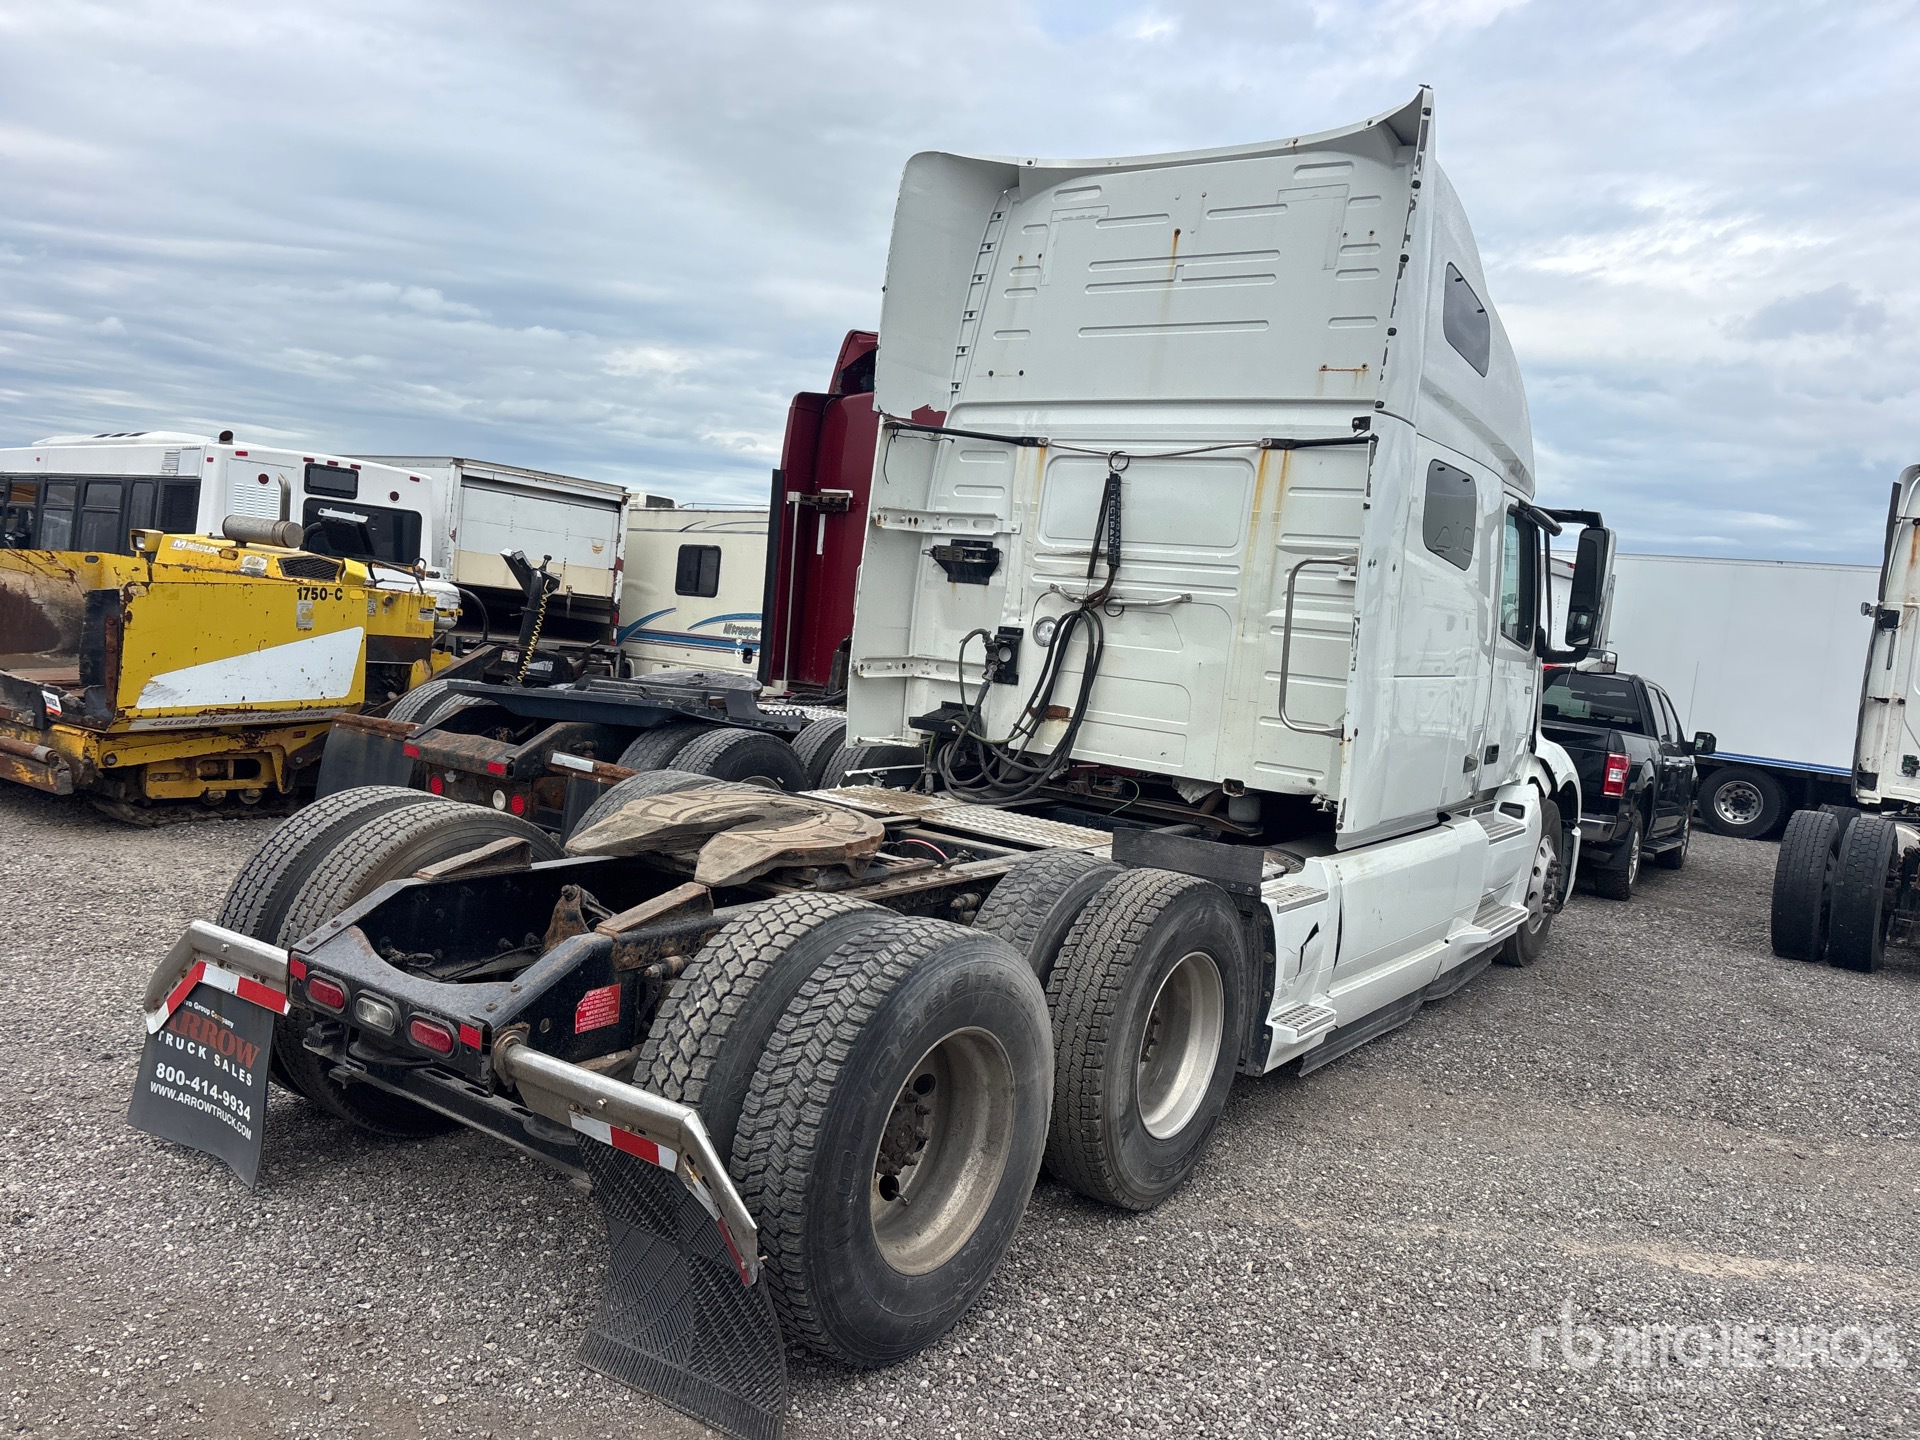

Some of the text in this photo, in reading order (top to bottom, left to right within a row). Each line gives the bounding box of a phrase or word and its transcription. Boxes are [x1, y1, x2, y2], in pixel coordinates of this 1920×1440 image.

[297, 587, 343, 600] 1750-C
[153, 711, 326, 726] CALDER BROTHERS CORPORATION
[194, 1002, 210, 1016] Group
[158, 1030, 252, 1086] TRUCK SALES
[166, 1010, 260, 1069] ARROW
[150, 1080, 252, 1140] WWW.ARROWTRUCK.COM
[156, 1062, 251, 1121] 800-414-9934
